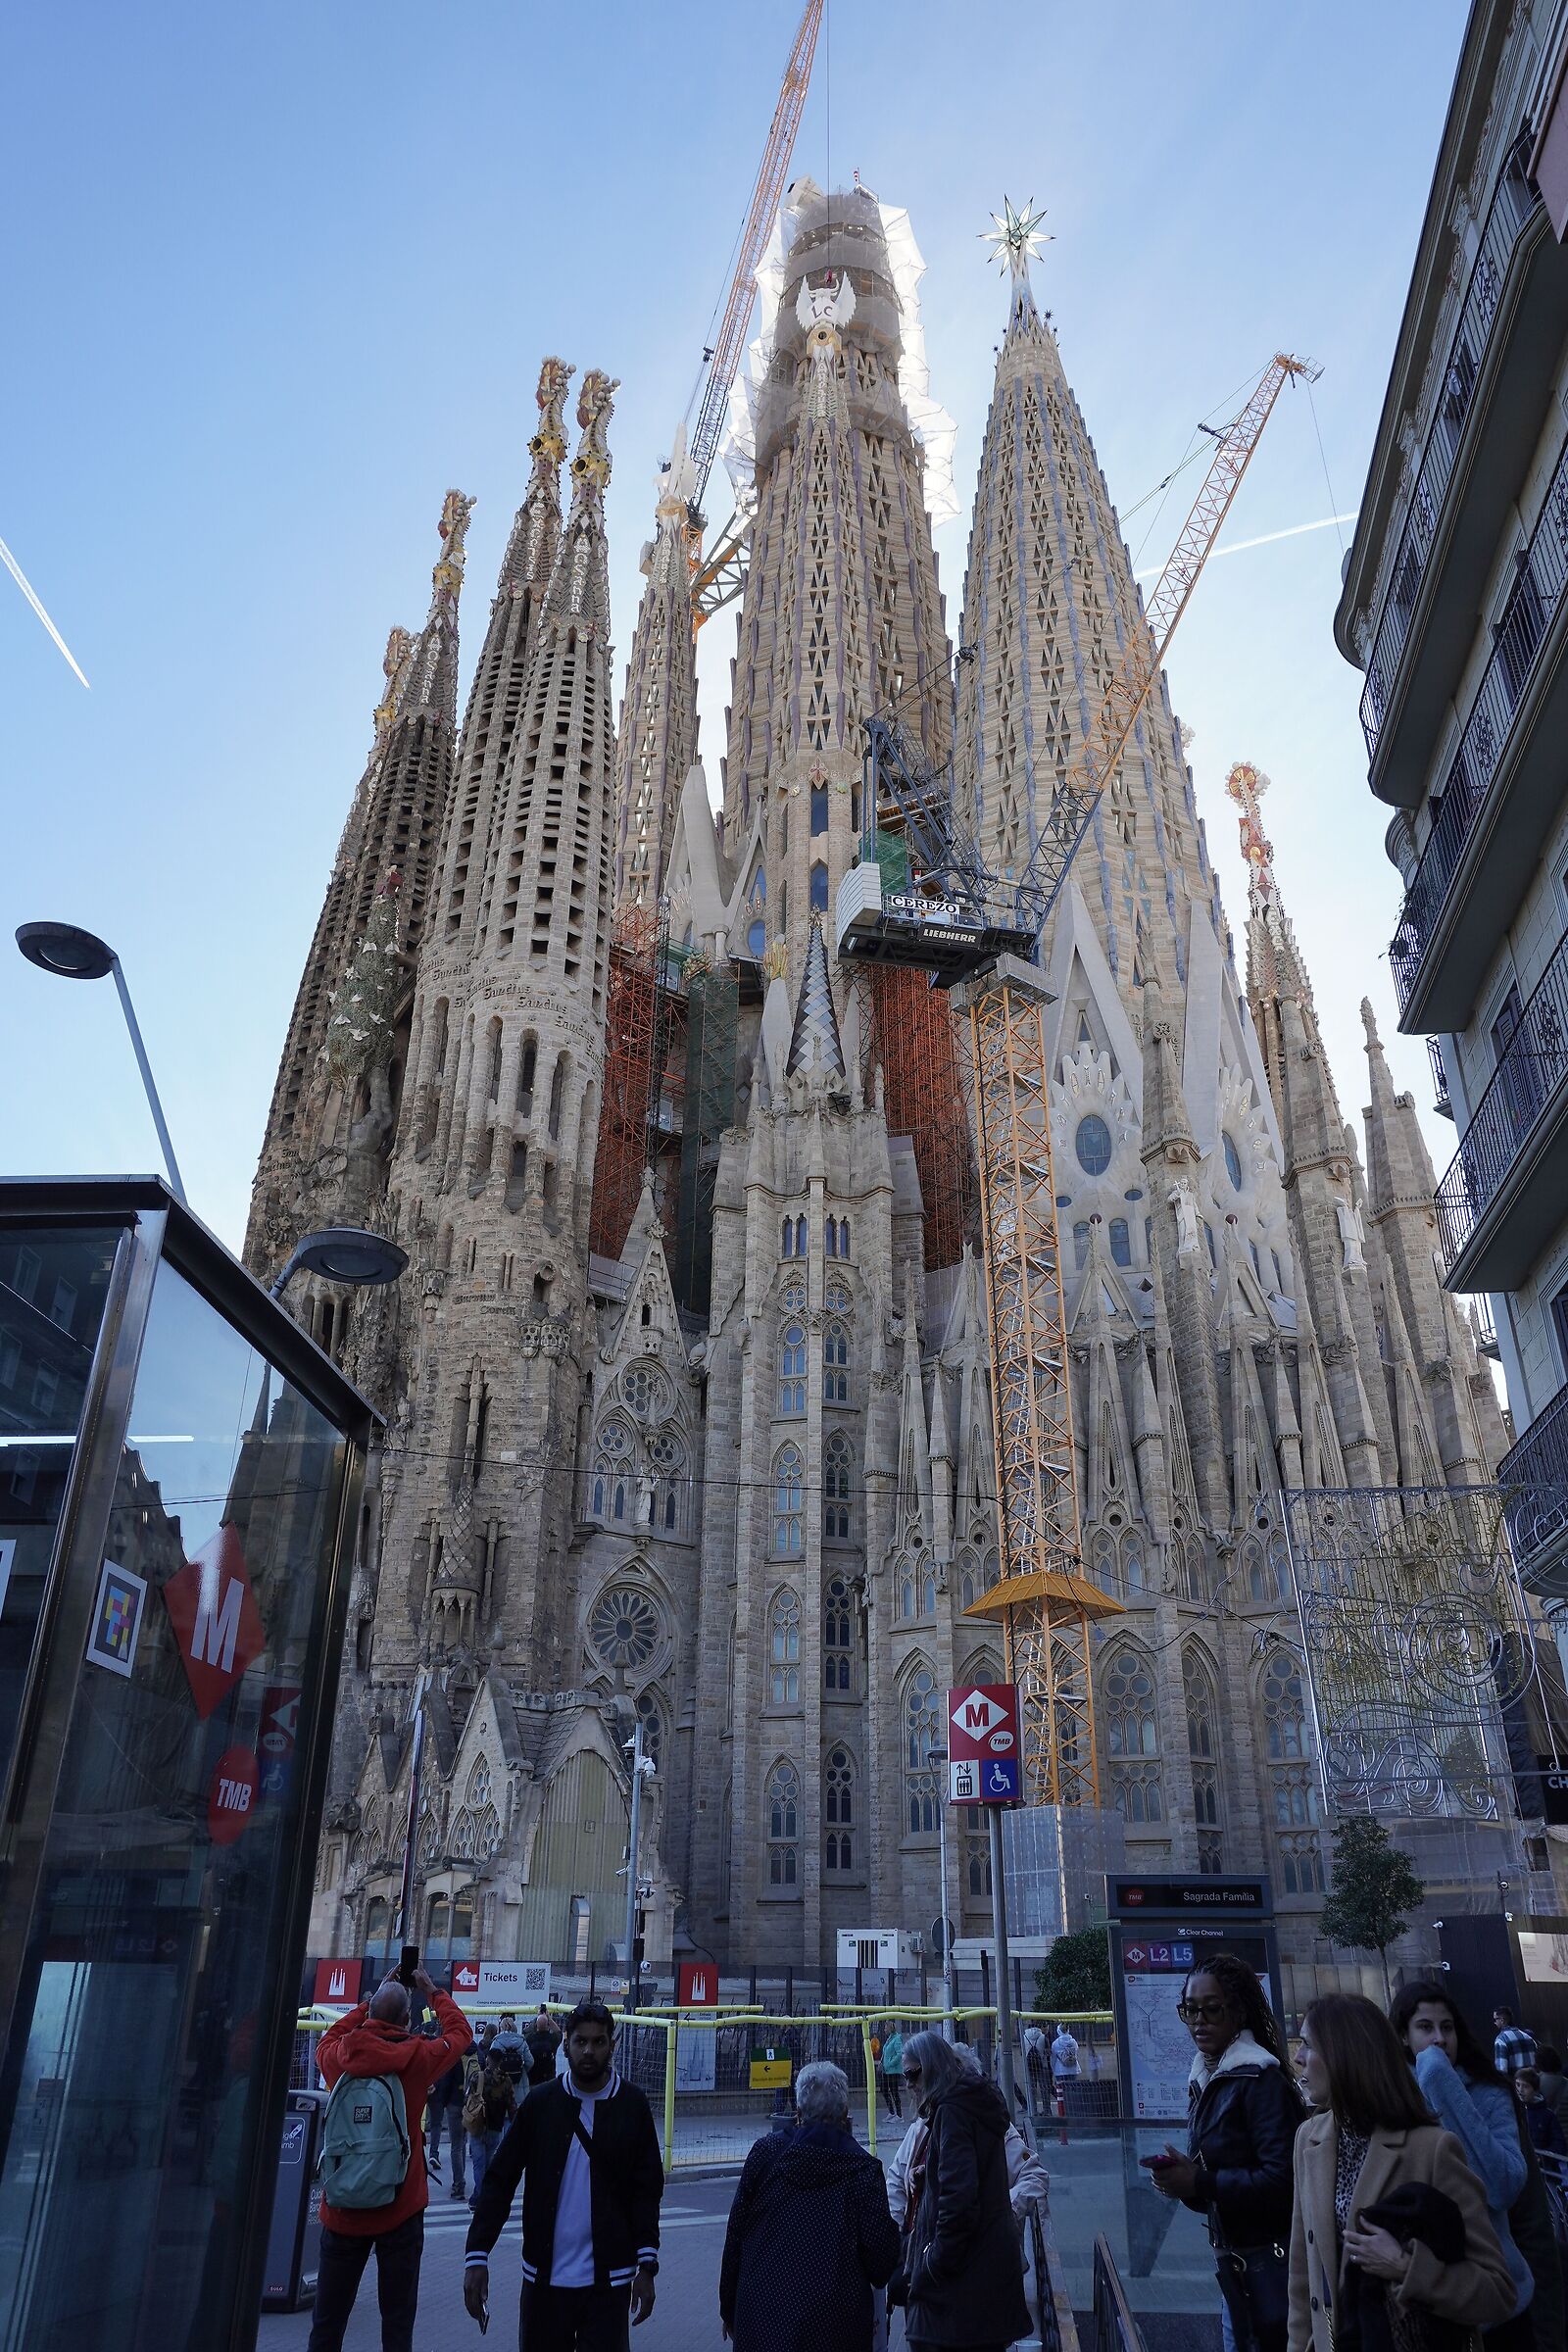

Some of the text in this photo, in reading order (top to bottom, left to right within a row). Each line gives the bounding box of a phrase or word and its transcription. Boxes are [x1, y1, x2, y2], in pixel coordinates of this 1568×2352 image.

[892, 896, 957, 914] CEREZO
[923, 928, 977, 943] LIEBHERR
[517, 996, 567, 1014] Sanctus
[190, 1564, 245, 1674] M
[965, 1703, 990, 1729] M
[217, 1778, 252, 1812] TMB
[1183, 1891, 1221, 1903] Sagrada
[1150, 1947, 1193, 1962] L2 L5
[483, 1972, 518, 1983] Tickets
